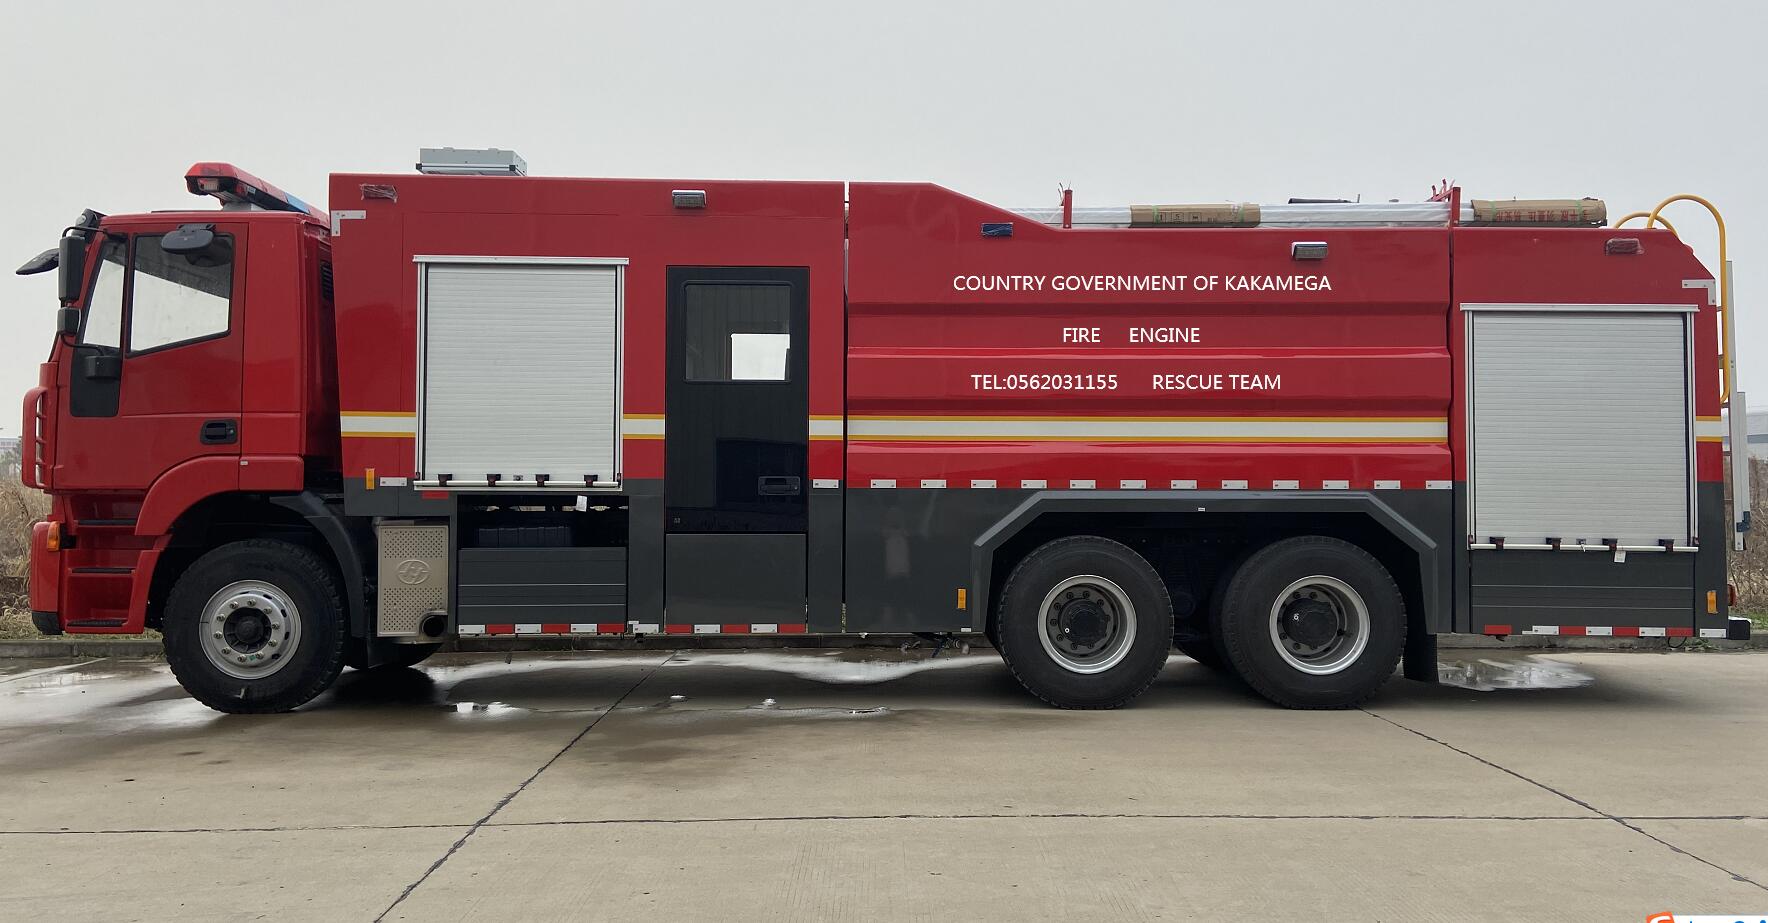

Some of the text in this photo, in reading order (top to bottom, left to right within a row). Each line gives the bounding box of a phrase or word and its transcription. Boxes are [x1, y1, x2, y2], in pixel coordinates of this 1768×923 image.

[953, 275, 1332, 291] COUNTRY GOVERNMENT OF KAKAMEGA
[1063, 327, 1201, 343] FIRE ENGINE
[971, 374, 1281, 390] TEL:0562031155 RESCUE TEAM
